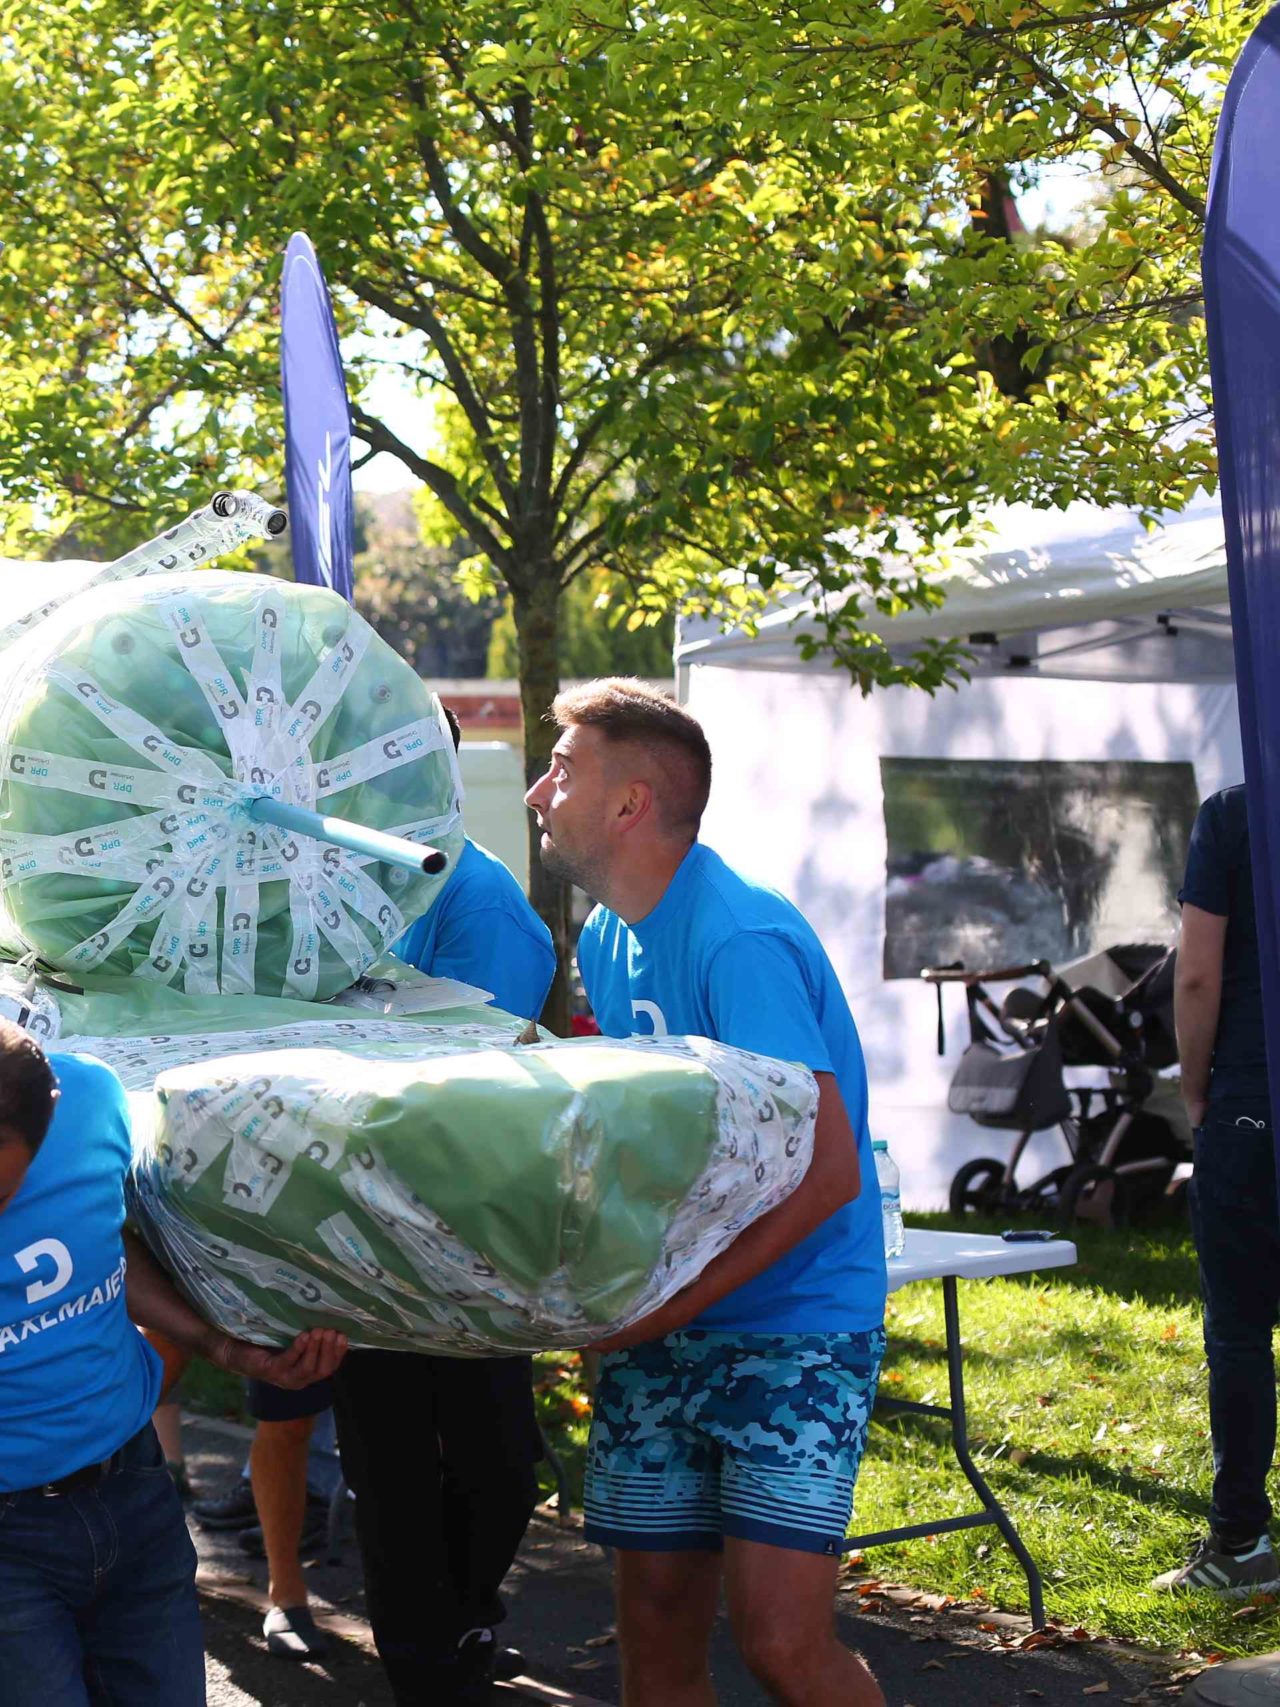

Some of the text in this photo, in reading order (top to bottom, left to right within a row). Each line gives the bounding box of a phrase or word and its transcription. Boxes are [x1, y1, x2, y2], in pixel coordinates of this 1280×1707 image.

[177, 607, 192, 625] DPR
[331, 656, 344, 673] DPR
[214, 678, 229, 697] DPR
[255, 708, 264, 727] DPR
[288, 718, 304, 737] DPR
[404, 738, 423, 752] DPR
[161, 750, 182, 767] DPR
[30, 767, 49, 777] DPR
[335, 770, 353, 782] DPR
[113, 782, 133, 794] DPR
[203, 797, 224, 808] DPR
[186, 814, 207, 826] DPR
[100, 839, 121, 851] DPR
[187, 833, 208, 850] DPR
[18, 860, 37, 872] DPR
[207, 858, 221, 876] DPR
[338, 875, 355, 893] DPR
[135, 895, 154, 913] DPR
[318, 890, 331, 909] DPR
[232, 937, 241, 956] DPR
[241, 1115, 262, 1140] DPR
[275, 1268, 299, 1281] DPR
